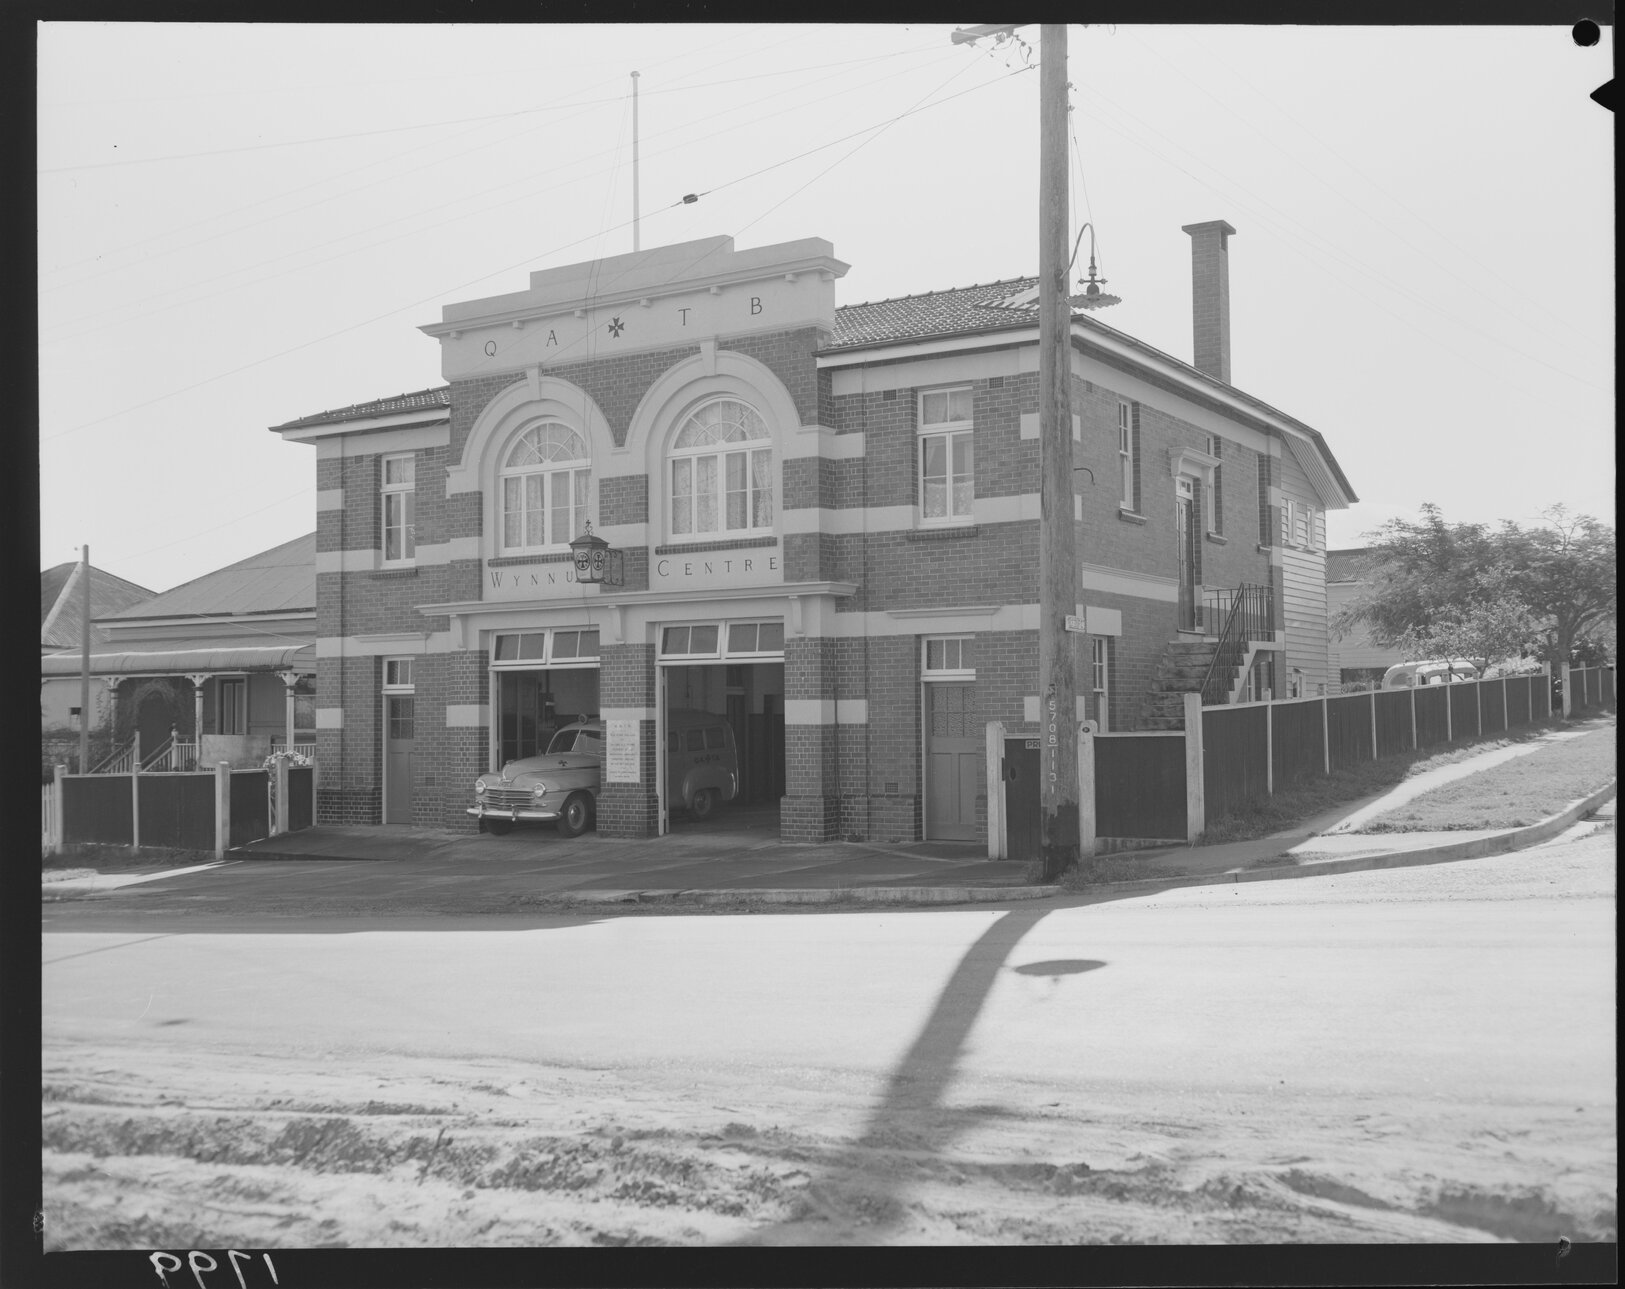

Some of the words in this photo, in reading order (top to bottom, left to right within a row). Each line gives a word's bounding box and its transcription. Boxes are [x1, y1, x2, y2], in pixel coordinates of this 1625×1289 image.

[484, 340, 497, 358] Q
[546, 329, 558, 347] A
[678, 307, 692, 326] T
[750, 297, 763, 315] B
[657, 557, 778, 577] CENTRE
[490, 570, 578, 588] WYNNU
